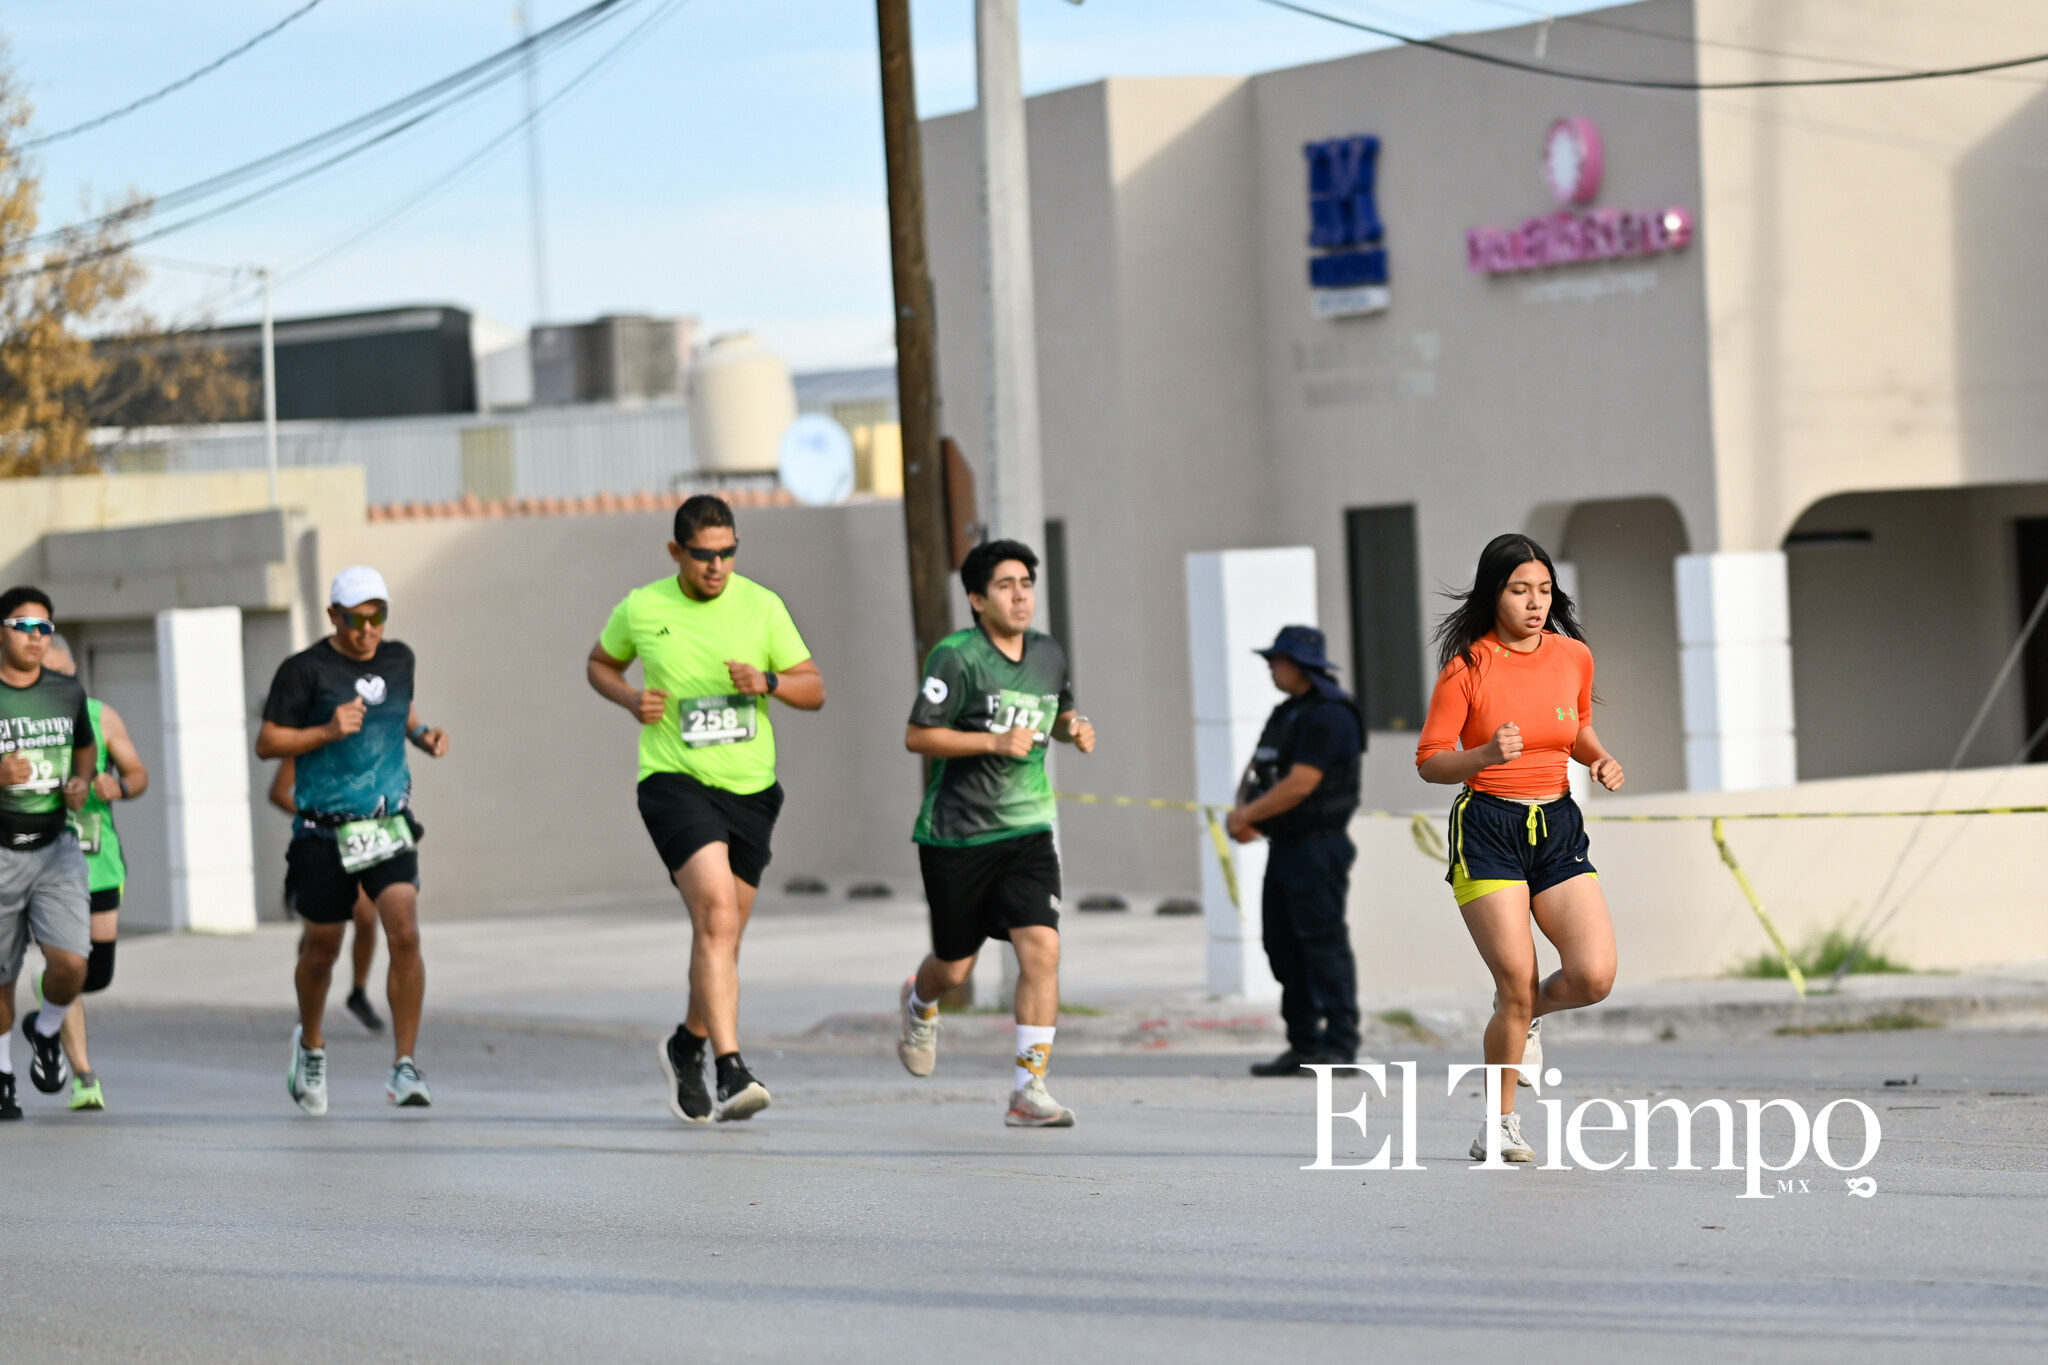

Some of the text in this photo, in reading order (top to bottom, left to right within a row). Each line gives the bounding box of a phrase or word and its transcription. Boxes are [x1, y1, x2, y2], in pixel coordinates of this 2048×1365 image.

[689, 708, 738, 732] 258
[1005, 706, 1044, 730] 147
[17, 733, 66, 749] todos
